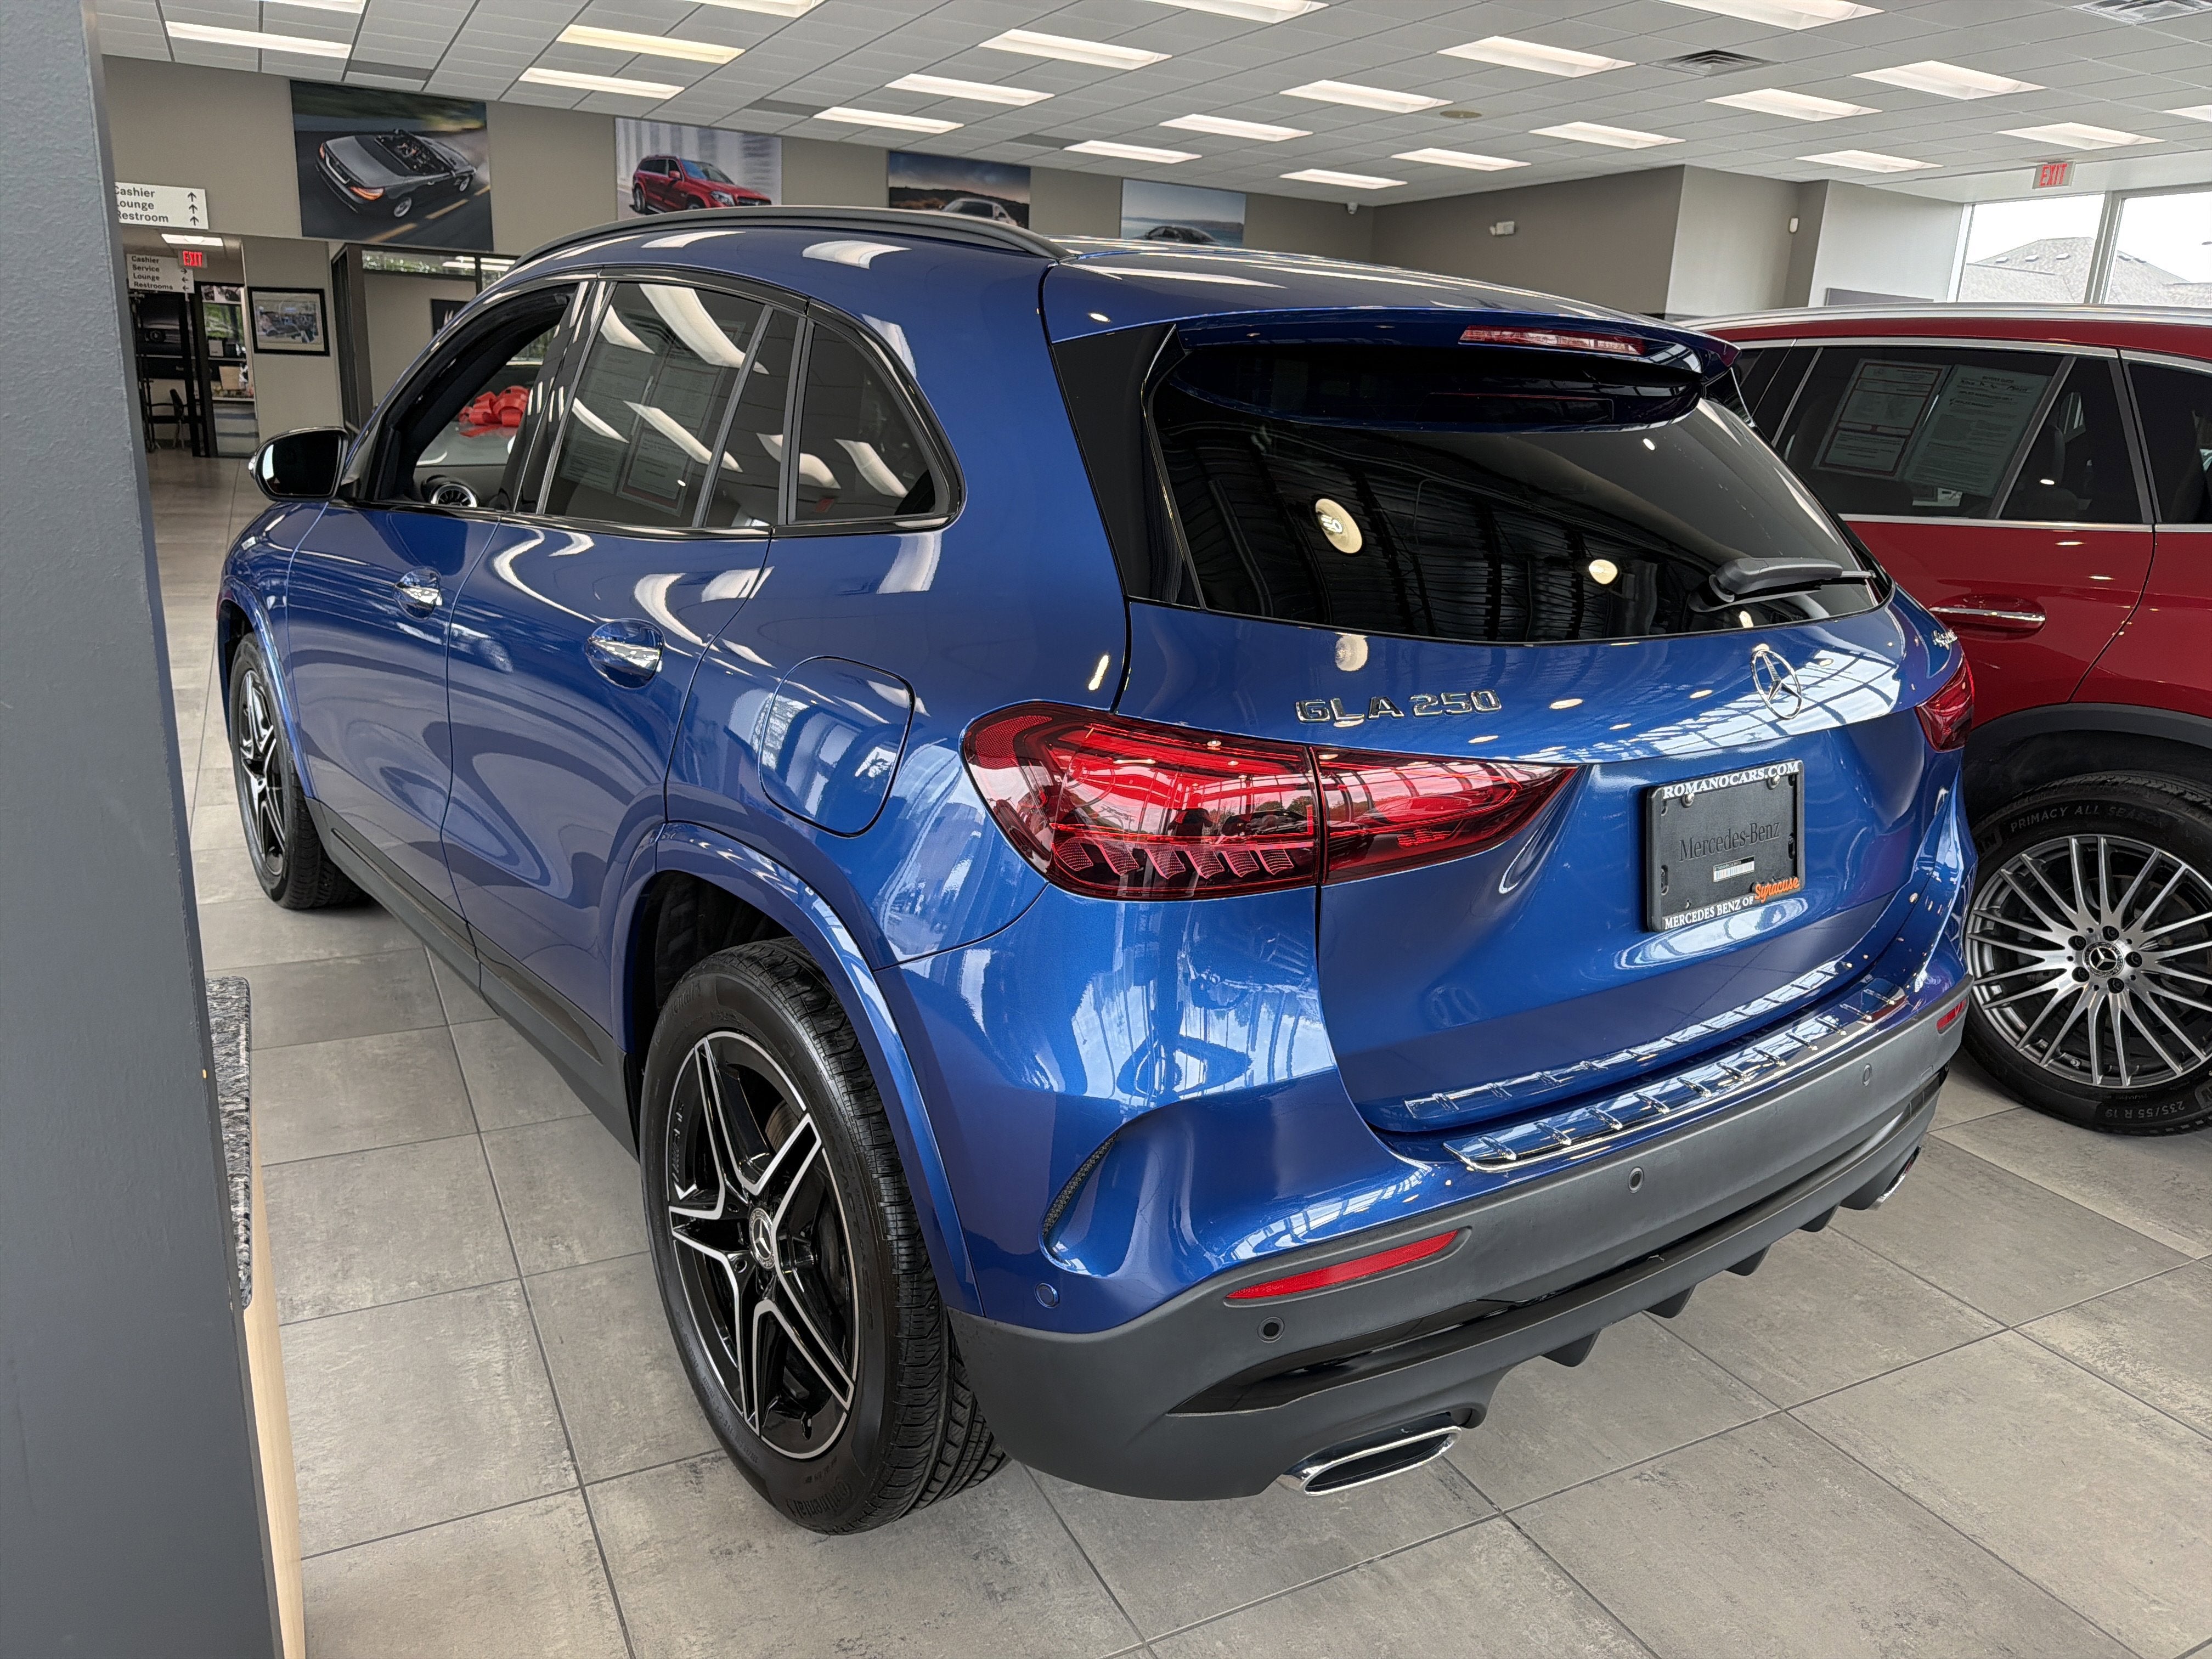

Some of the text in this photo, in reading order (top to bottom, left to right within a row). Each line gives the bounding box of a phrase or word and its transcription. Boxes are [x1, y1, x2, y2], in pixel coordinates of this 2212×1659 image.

[2039, 163, 2068, 187] EXIT
[115, 185, 155, 198] Cashier
[117, 200, 154, 211] ounge
[183, 251, 202, 268] EXIT
[133, 273, 160, 282] Lounge
[134, 281, 173, 290] Restrooms
[1295, 689, 1502, 724] GLA 250
[1662, 760, 1799, 799] ROMANOCARS.COM
[2010, 806, 2068, 832] PRIMACY
[2074, 805, 2099, 816] ALL
[1679, 822, 1780, 862] Mercedes-Benz
[1664, 877, 1799, 930] MERCEDES BENZ OF Syracuse
[2105, 1101, 2185, 1119] 235/55 R 19
